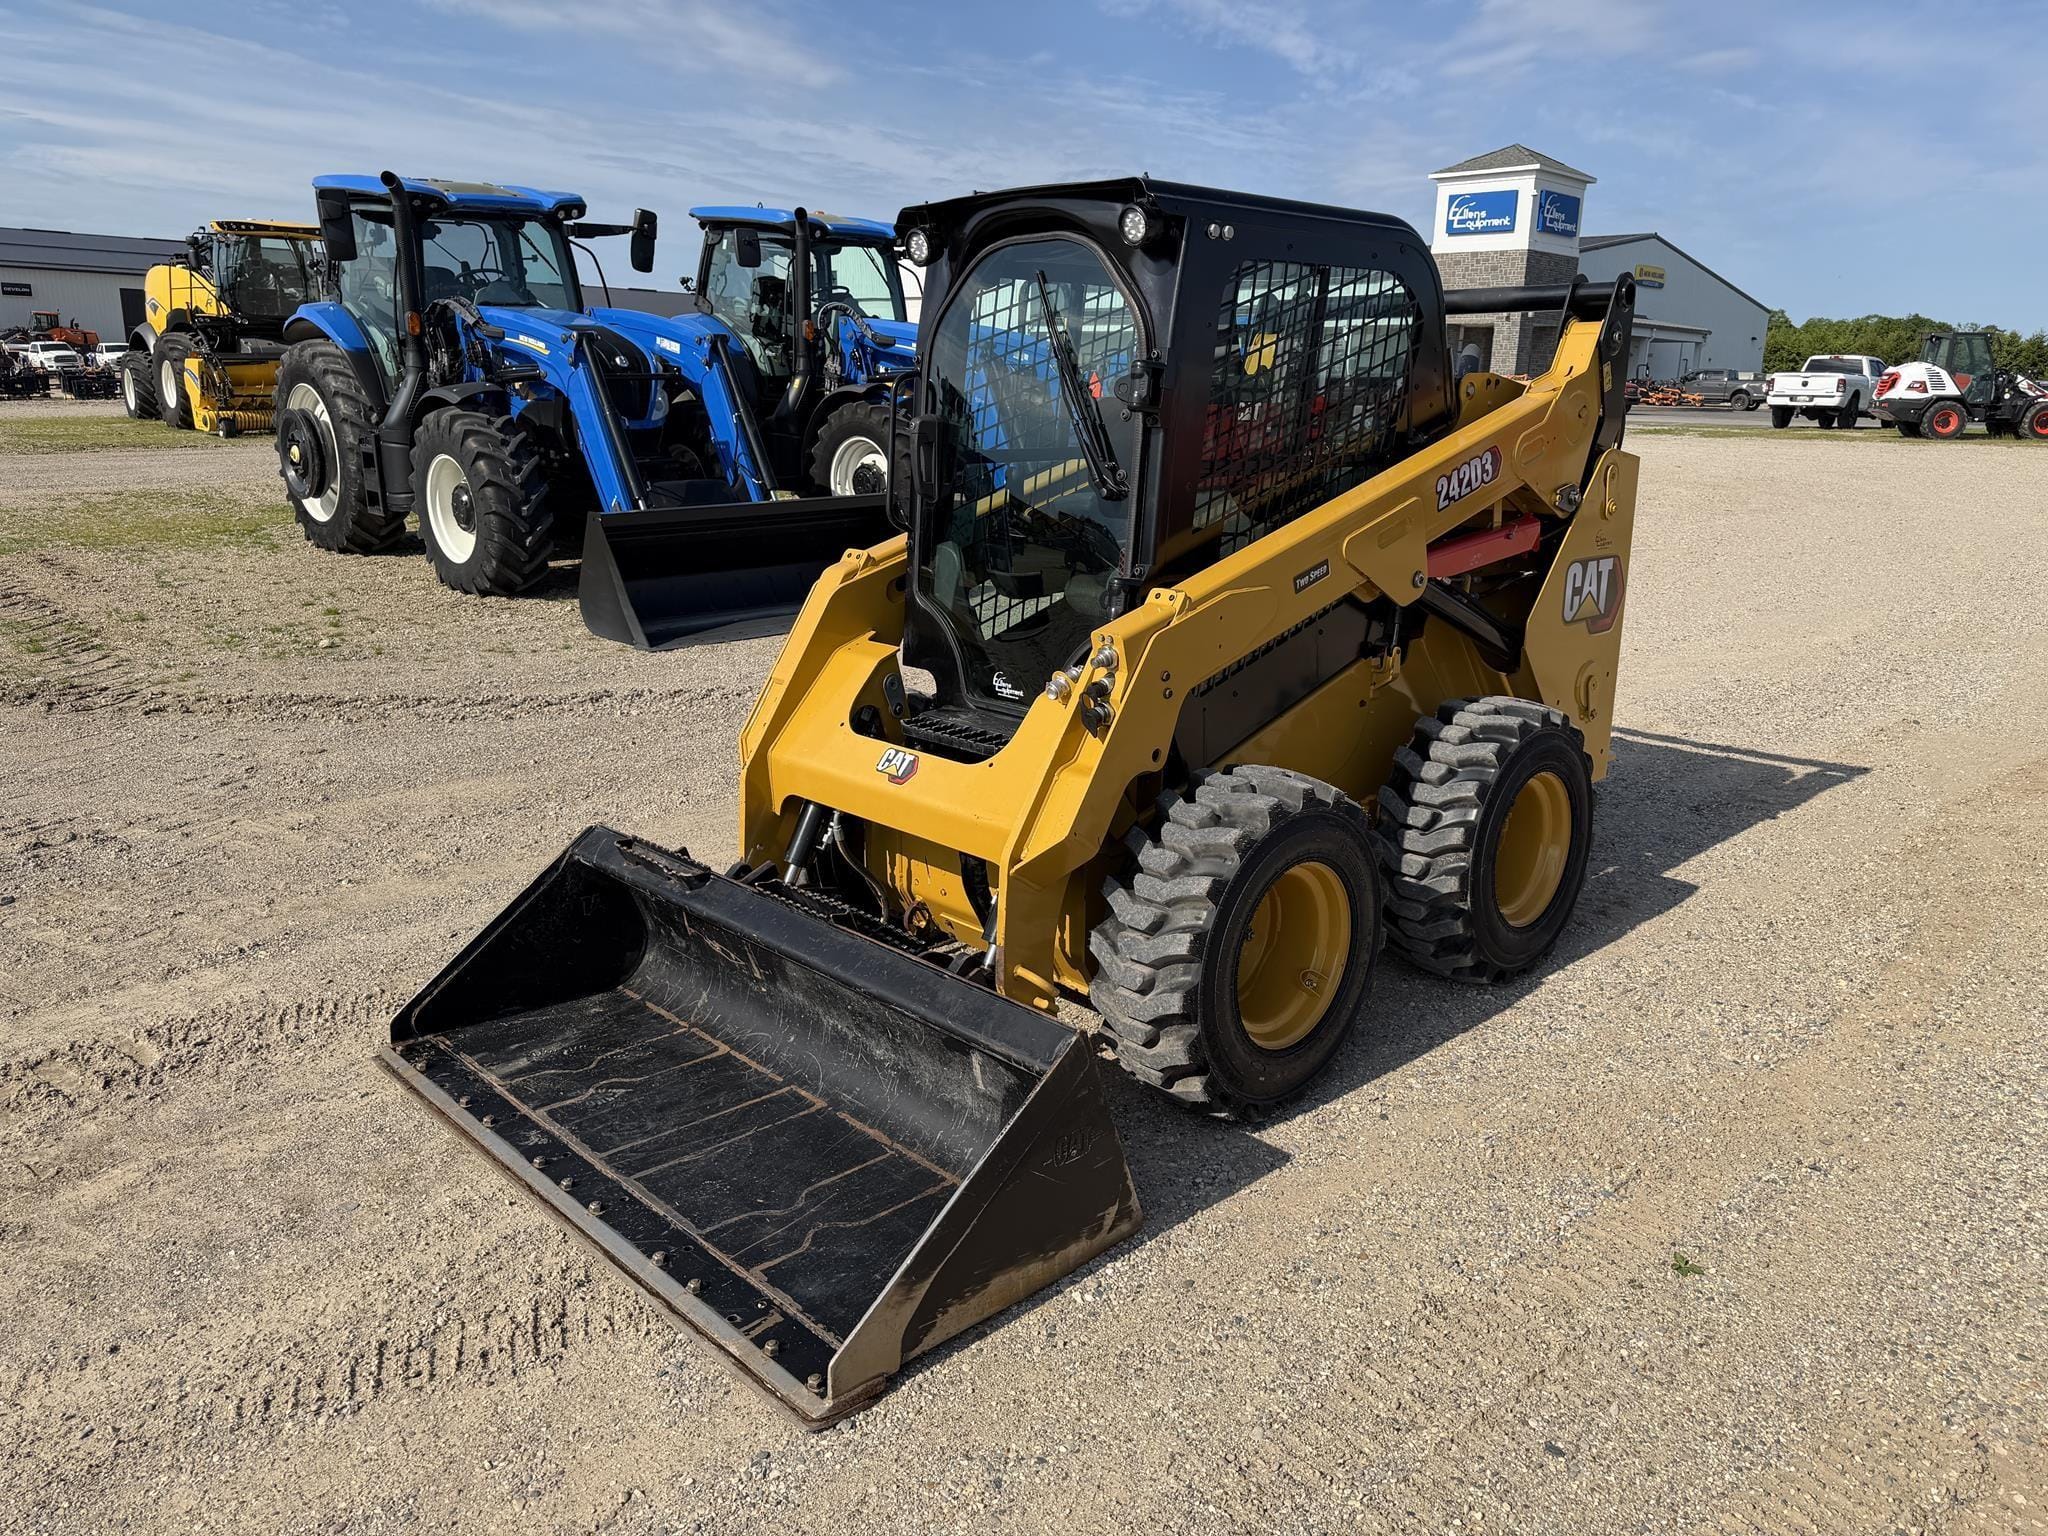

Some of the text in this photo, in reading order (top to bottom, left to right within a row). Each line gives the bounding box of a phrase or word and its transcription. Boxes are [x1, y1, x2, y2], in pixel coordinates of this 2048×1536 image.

[1448, 194, 1487, 221] Ellens
[1453, 201, 1511, 231] Equipment
[1544, 194, 1566, 220] Ellens
[1546, 202, 1577, 233] Equipment
[1437, 451, 1493, 510] 242D3
[1563, 557, 1614, 622] CAT
[876, 748, 915, 777] CAT
